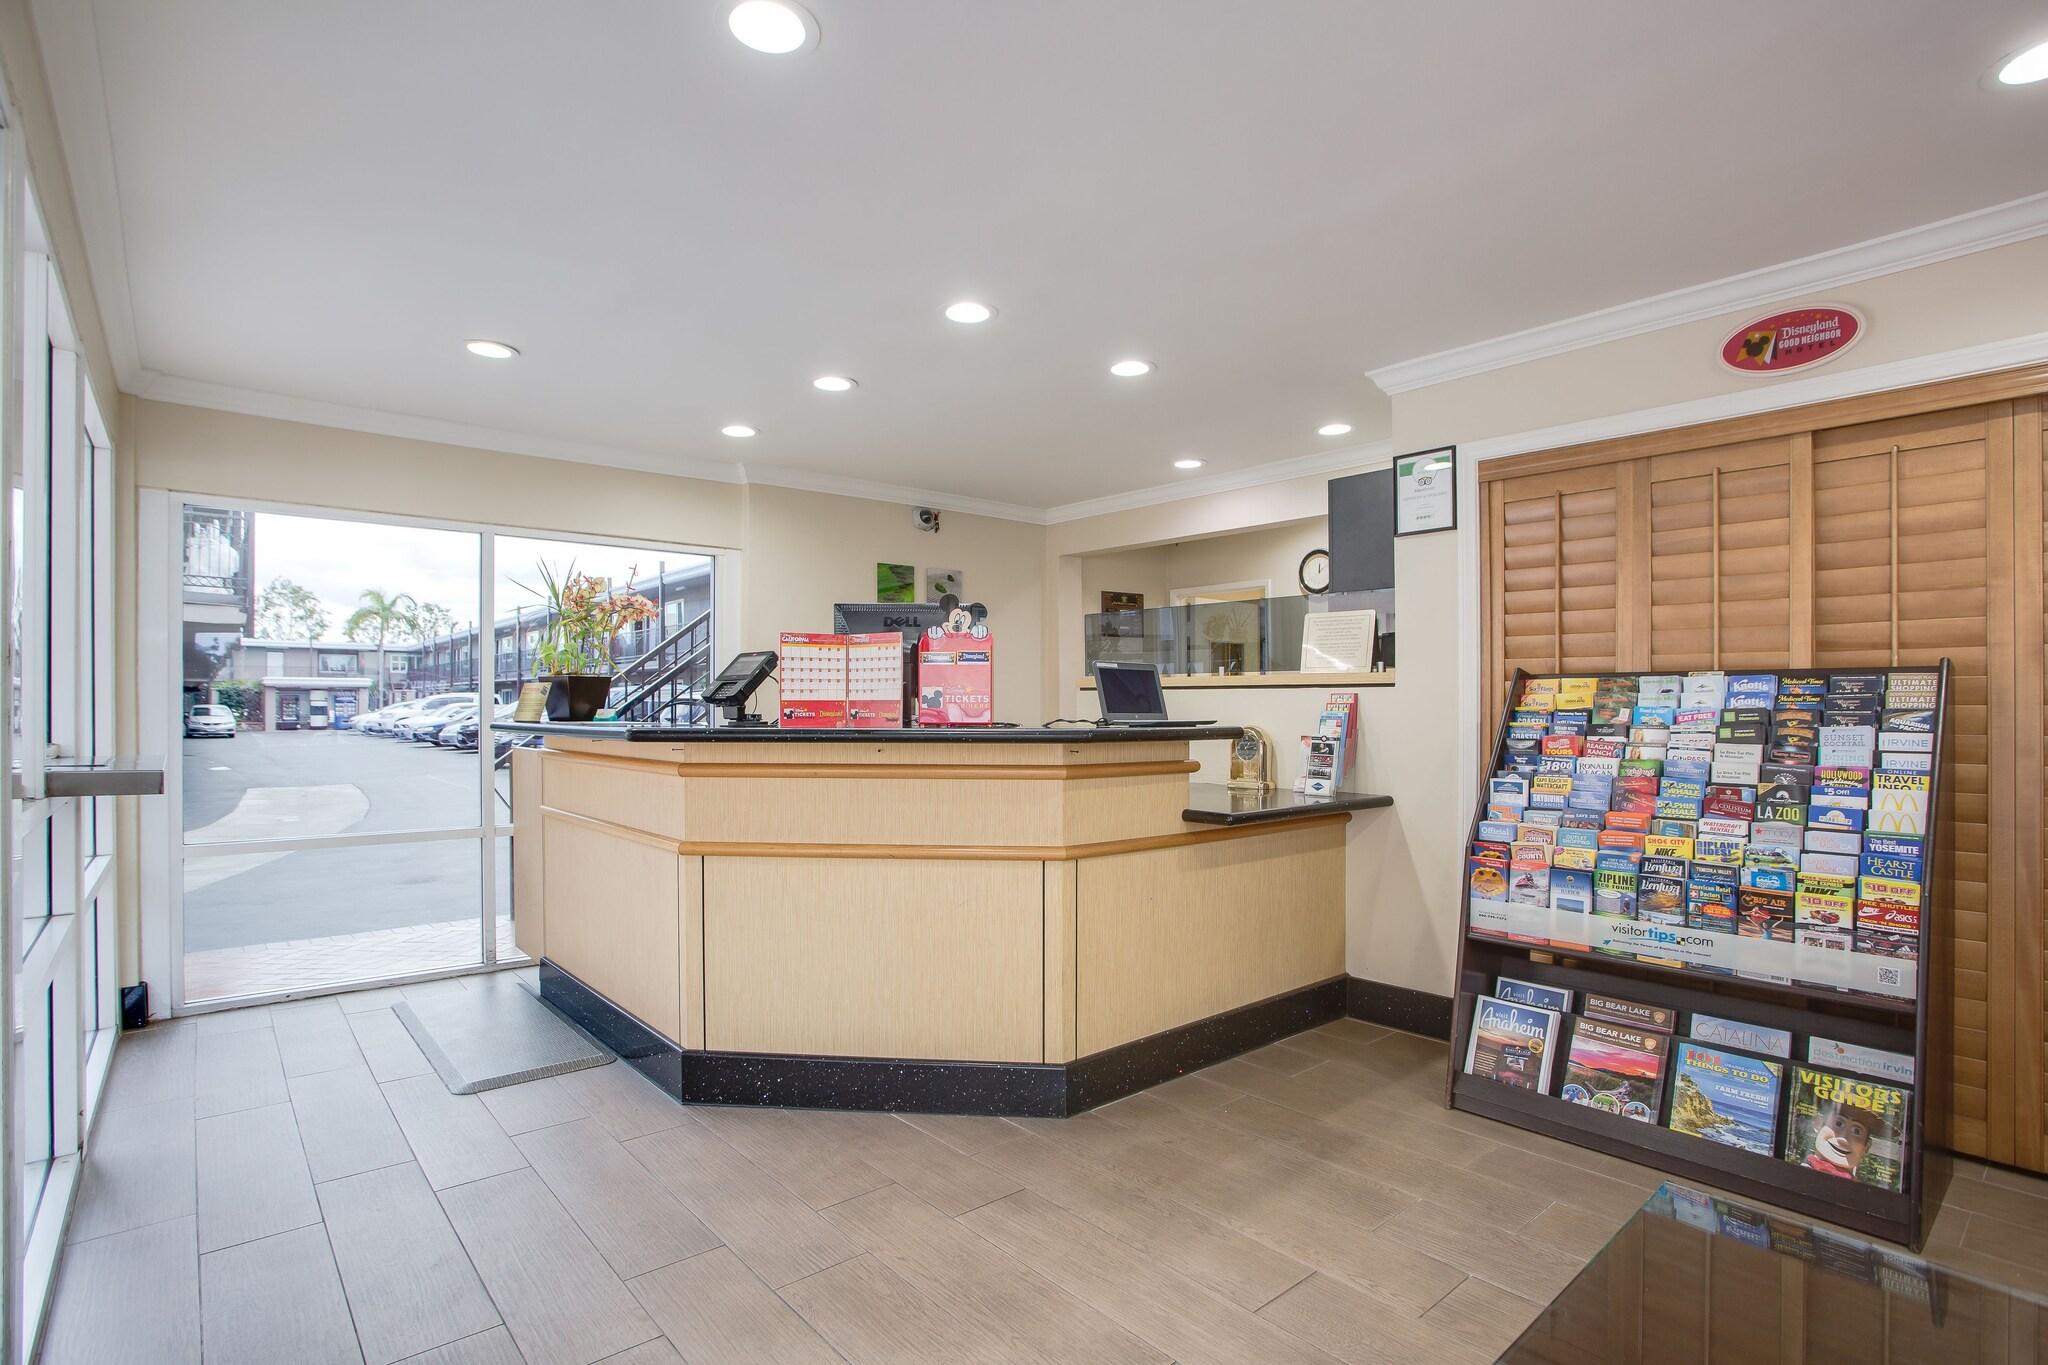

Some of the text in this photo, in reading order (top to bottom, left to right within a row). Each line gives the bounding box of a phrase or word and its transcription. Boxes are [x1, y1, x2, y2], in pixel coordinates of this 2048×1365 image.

[1781, 316, 1839, 338] Disneyland
[1779, 329, 1840, 348] GOOD NEIGHBOR
[1785, 340, 1835, 355] HOTEL
[883, 616, 920, 628] DELL
[1733, 679, 1768, 692] Knott's
[1782, 677, 1806, 685] Medieval
[944, 695, 989, 703] TICKETS
[1730, 695, 1766, 708] Knott's
[1778, 694, 1802, 702] Medieval
[1693, 712, 1712, 720] FREE
[1890, 718, 1930, 730] AQUARIUM
[1586, 744, 1614, 752] REAGAN
[1887, 760, 1928, 768] IRVINE
[1821, 770, 1863, 780] HOLLYWOOD
[1876, 774, 1924, 785] TRAVEL
[1664, 781, 1700, 789] DOLPHIN
[1667, 788, 1700, 797] WHALE
[1824, 787, 1834, 796] $5
[1658, 802, 1696, 810] DOLPHIN
[1718, 803, 1752, 814] COLISEUM
[1757, 806, 1800, 820] LA ZOO
[1703, 821, 1742, 829] WATERCRAFT
[1481, 826, 1509, 836] Official
[1525, 836, 1552, 844] COUNTY
[1670, 838, 1686, 846] CITY
[1696, 840, 1740, 850] BIPLANE
[1654, 848, 1677, 857] NIKE
[1696, 848, 1732, 856] RIDES!
[1868, 844, 1919, 854] YOSEMITE
[1868, 856, 1916, 870] HEARST
[1644, 861, 1684, 878] Ventura
[1870, 866, 1914, 878] CASTLE
[1598, 873, 1634, 886] ZIPLINE
[1642, 880, 1680, 896] Ventura
[1690, 884, 1731, 894] American Hotel
[1865, 882, 1916, 896] $10 OFF
[1770, 899, 1786, 907] AIR
[1800, 896, 1848, 908] $10 OFF
[1612, 923, 1714, 947] visitortips.com
[1590, 998, 1604, 1006] BIG
[1606, 1002, 1627, 1012] BEAR
[1629, 1006, 1650, 1016] LAKE
[1480, 1007, 1544, 1039] Anaheim
[1580, 1022, 1642, 1044] BIG BEAR LAKE
[1696, 1022, 1784, 1053] CATALINA
[1686, 1058, 1769, 1083] THINGS TO DO
[1800, 1070, 1901, 1104] VISITORS
[1814, 1086, 1885, 1113] GUIDE
